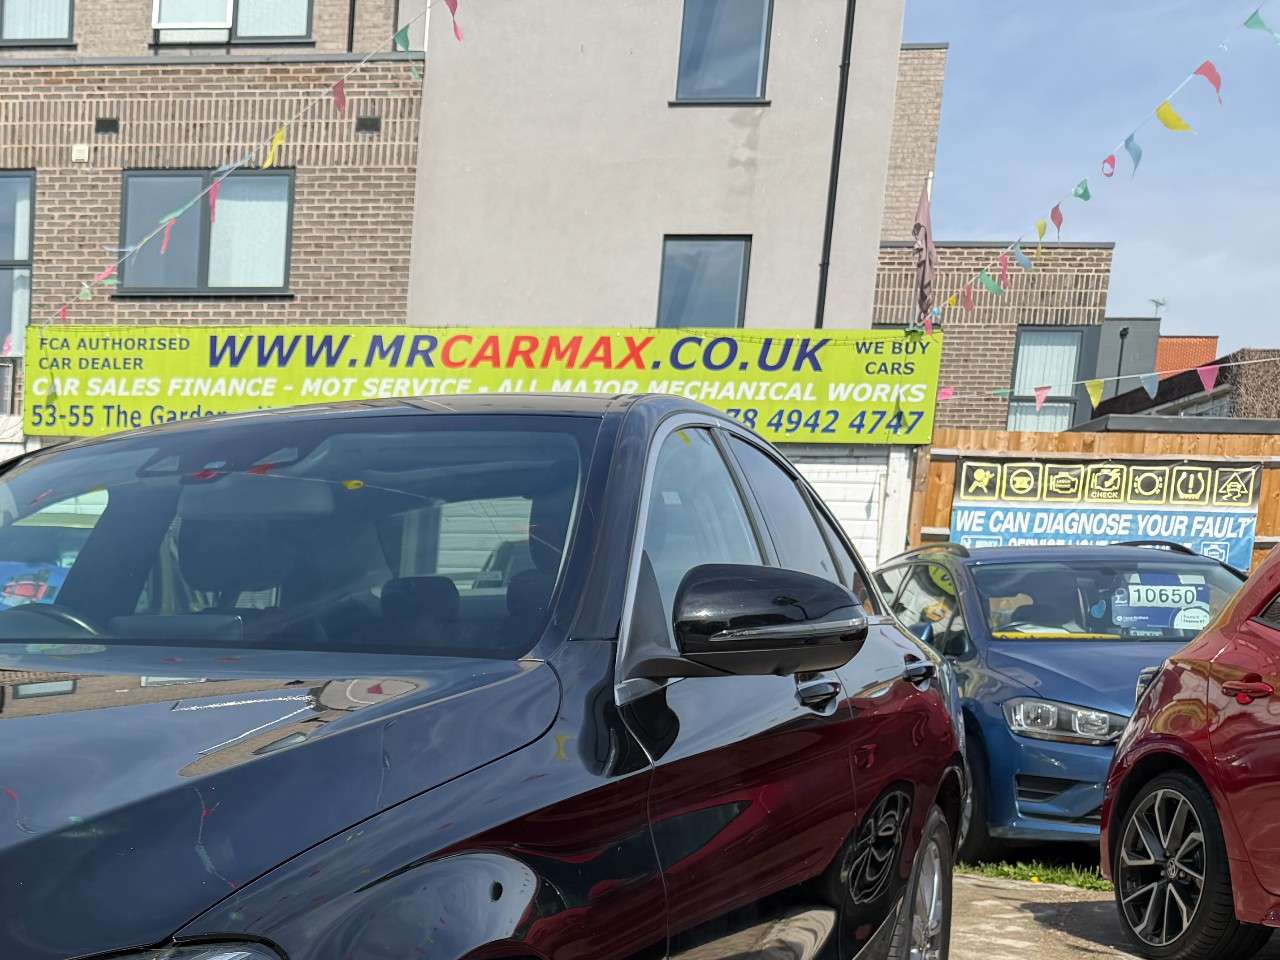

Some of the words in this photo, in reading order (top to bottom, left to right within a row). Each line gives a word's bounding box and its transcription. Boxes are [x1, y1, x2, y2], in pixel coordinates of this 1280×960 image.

[39, 337, 70, 350] FCA
[77, 337, 190, 350] AUTHORISED
[855, 341, 884, 354] WE
[891, 341, 931, 355] BUY
[208, 334, 831, 372] WWW.MRCARMAX.CO.UK
[39, 357, 72, 369] CAR
[78, 357, 144, 370] DEALER
[864, 361, 915, 375] CARS
[32, 377, 81, 397] CAR
[86, 377, 161, 397] SALES
[168, 377, 277, 397] FINANCE
[300, 377, 357, 397] MOT
[362, 377, 472, 398] SERVICE
[497, 378, 539, 394] ALL
[551, 379, 639, 395] MAJOR
[646, 379, 817, 401] MECHANICAL
[828, 382, 928, 402] WORKS
[31, 403, 94, 428] 53-55
[103, 404, 141, 429] The
[767, 408, 840, 434] 4942
[848, 410, 925, 435] 4747
[1090, 491, 1119, 499] CHECK
[956, 510, 986, 532] WE
[989, 511, 1031, 533] CAN
[1032, 512, 1133, 535] DIAGNOSE
[1137, 514, 1189, 537] YOUR
[1190, 516, 1247, 539] FAULT
[1134, 588, 1195, 604] 10650
